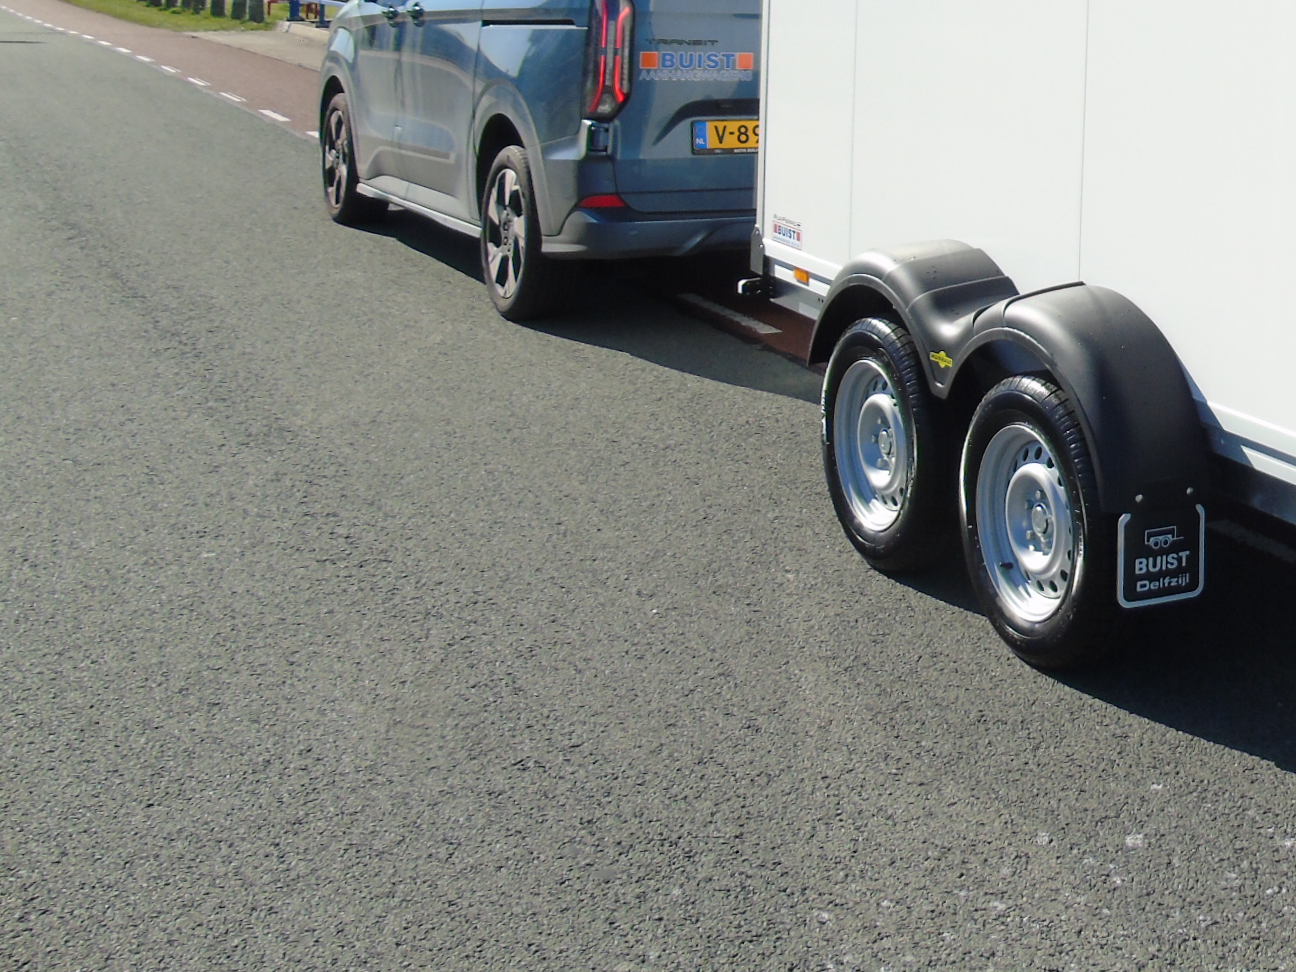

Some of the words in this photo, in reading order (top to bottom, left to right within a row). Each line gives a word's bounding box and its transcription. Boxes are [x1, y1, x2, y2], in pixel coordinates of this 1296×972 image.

[646, 38, 718, 46] TRANSIT
[661, 51, 736, 70] BUIST
[777, 224, 796, 240] BUIST
[1135, 550, 1190, 575] BUIST
[1136, 573, 1190, 592] Delfzijl
